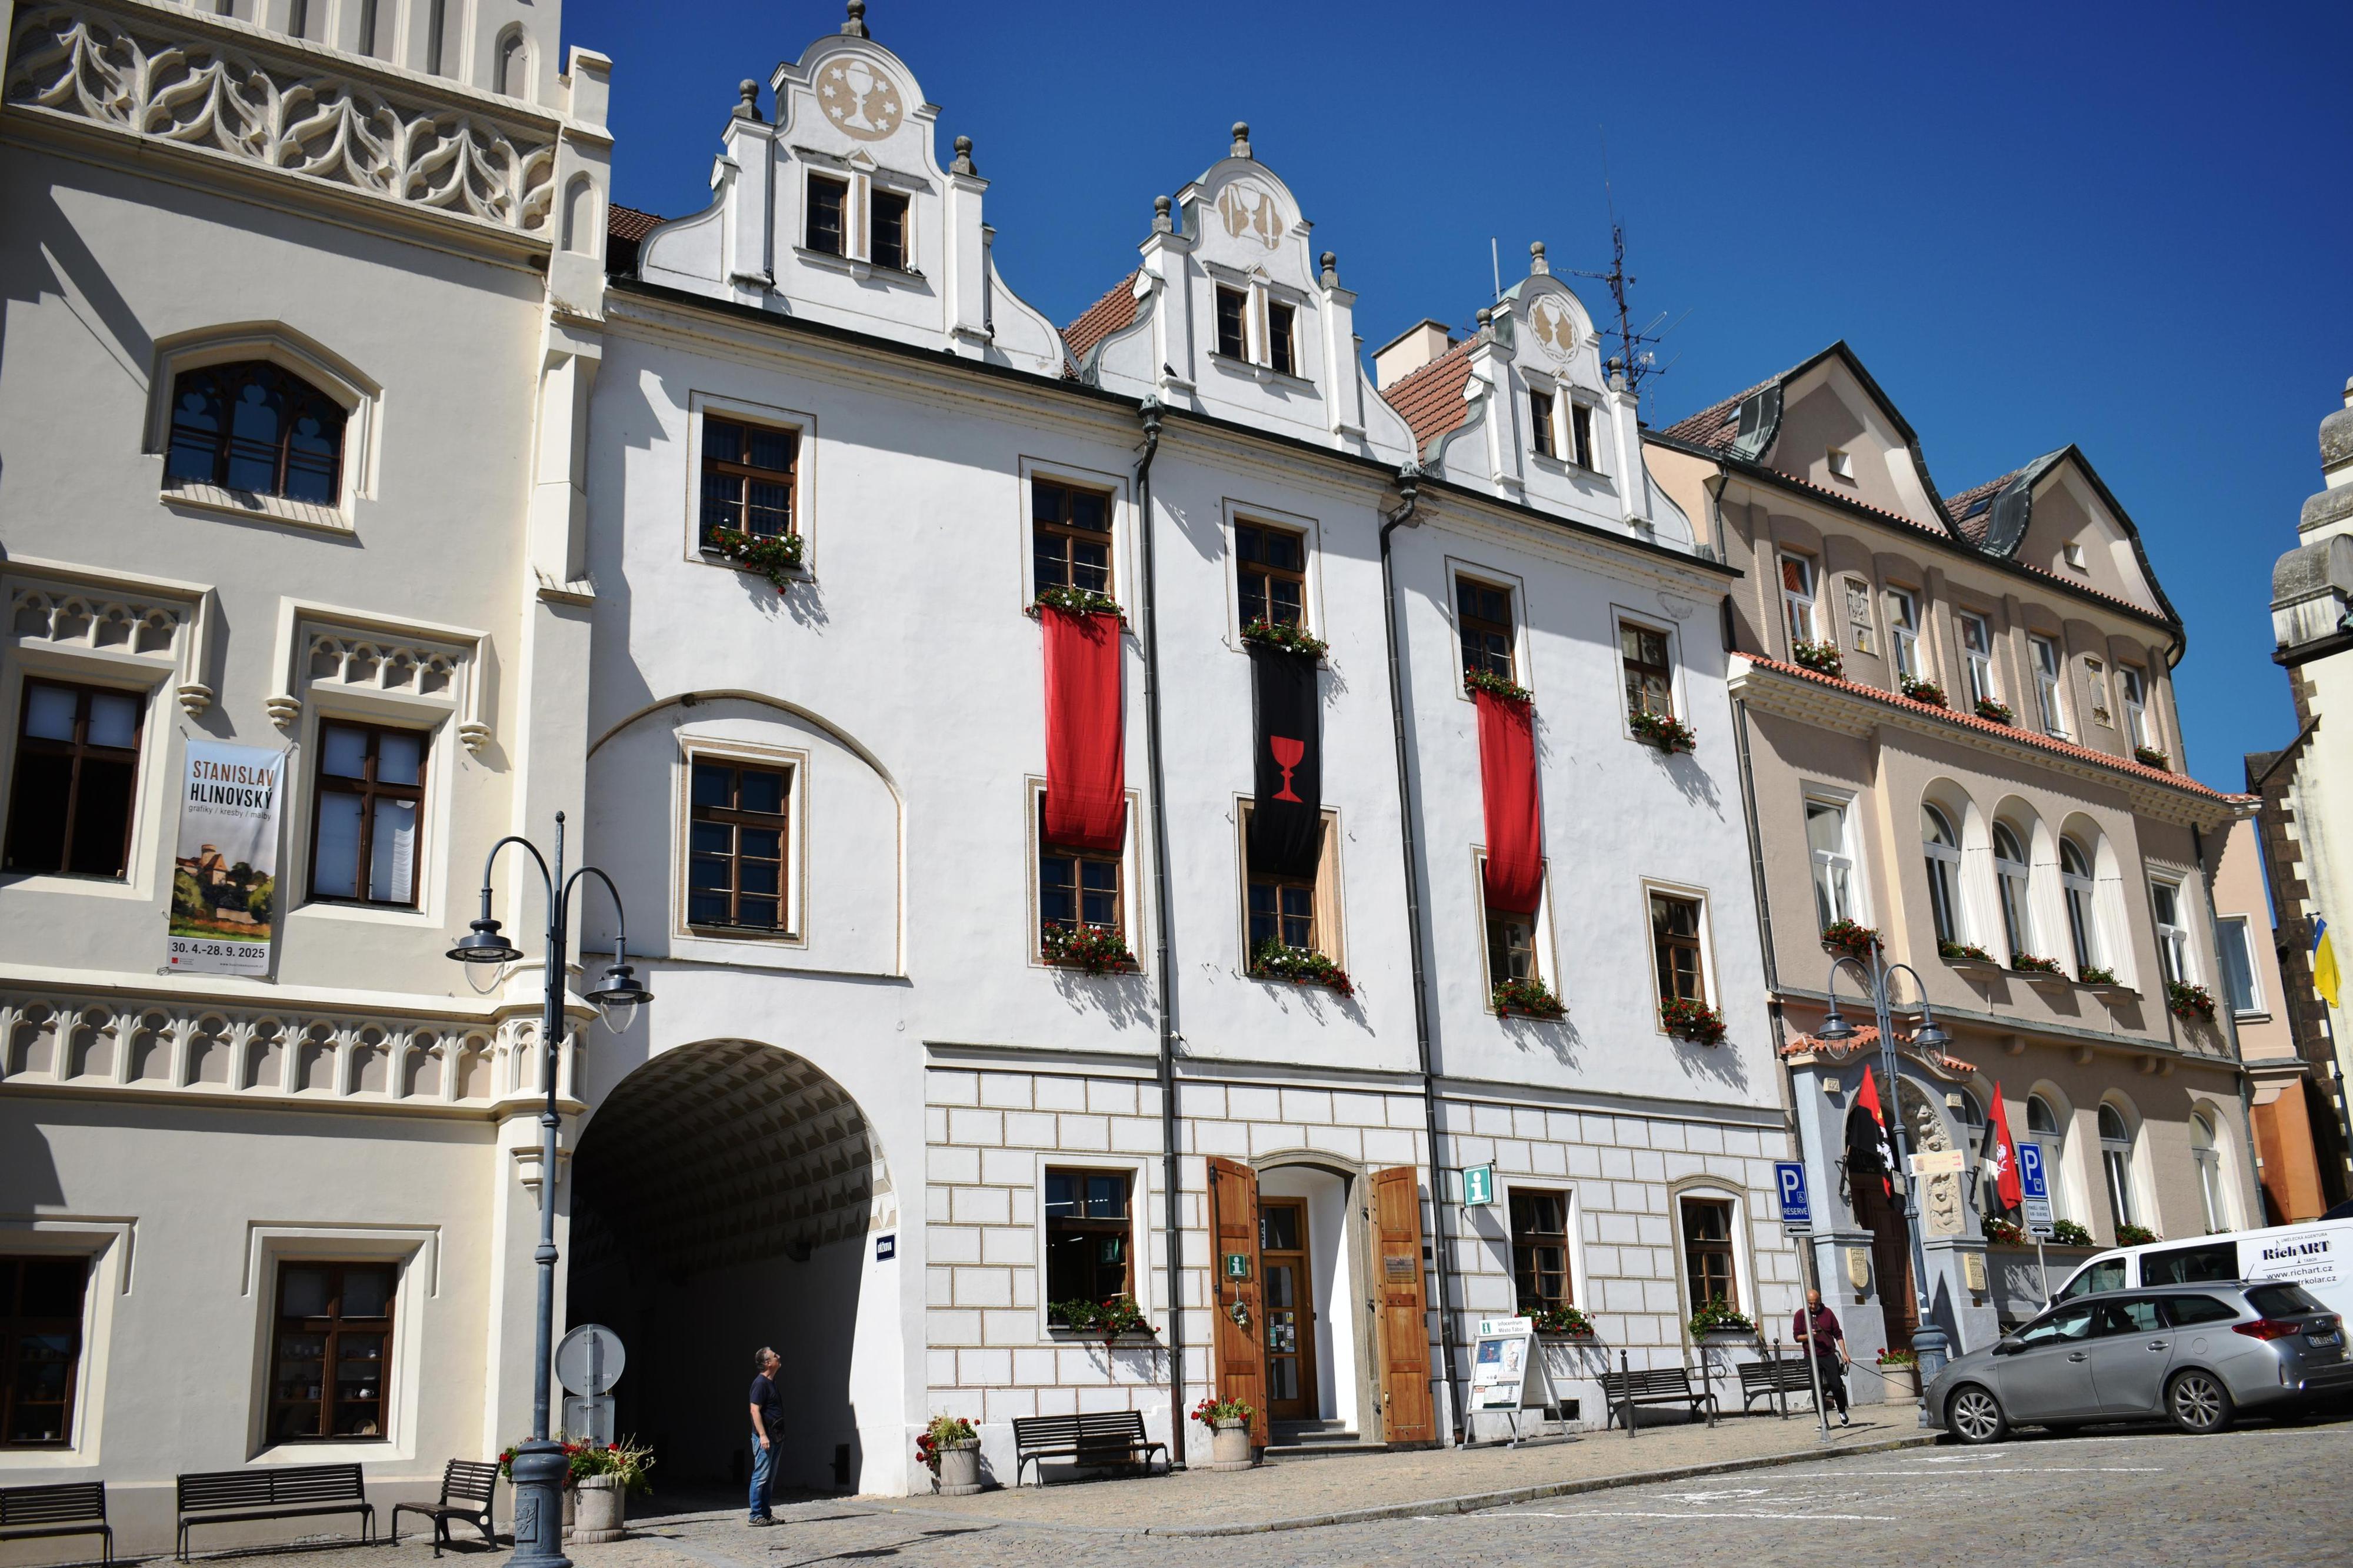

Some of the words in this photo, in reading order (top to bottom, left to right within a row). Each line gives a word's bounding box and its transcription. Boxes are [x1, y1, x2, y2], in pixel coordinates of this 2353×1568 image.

[194, 760, 274, 786] STANISLAV
[191, 783, 273, 809] HLINOVSKÝ
[188, 805, 213, 815] grafiky
[220, 808, 242, 818] kresby
[251, 812, 271, 821] malby
[172, 942, 188, 953] 30.
[192, 944, 223, 956] 4.-28.
[226, 946, 235, 957] 9.
[238, 948, 265, 958] 2025
[2024, 1150, 2038, 1180] P
[1781, 1170, 1799, 1203] P
[1784, 1207, 1808, 1215] RÉSERVÉ
[2267, 1266, 2333, 1279] www.richart.cz
[2298, 1275, 2337, 1285] trkolar.cz
